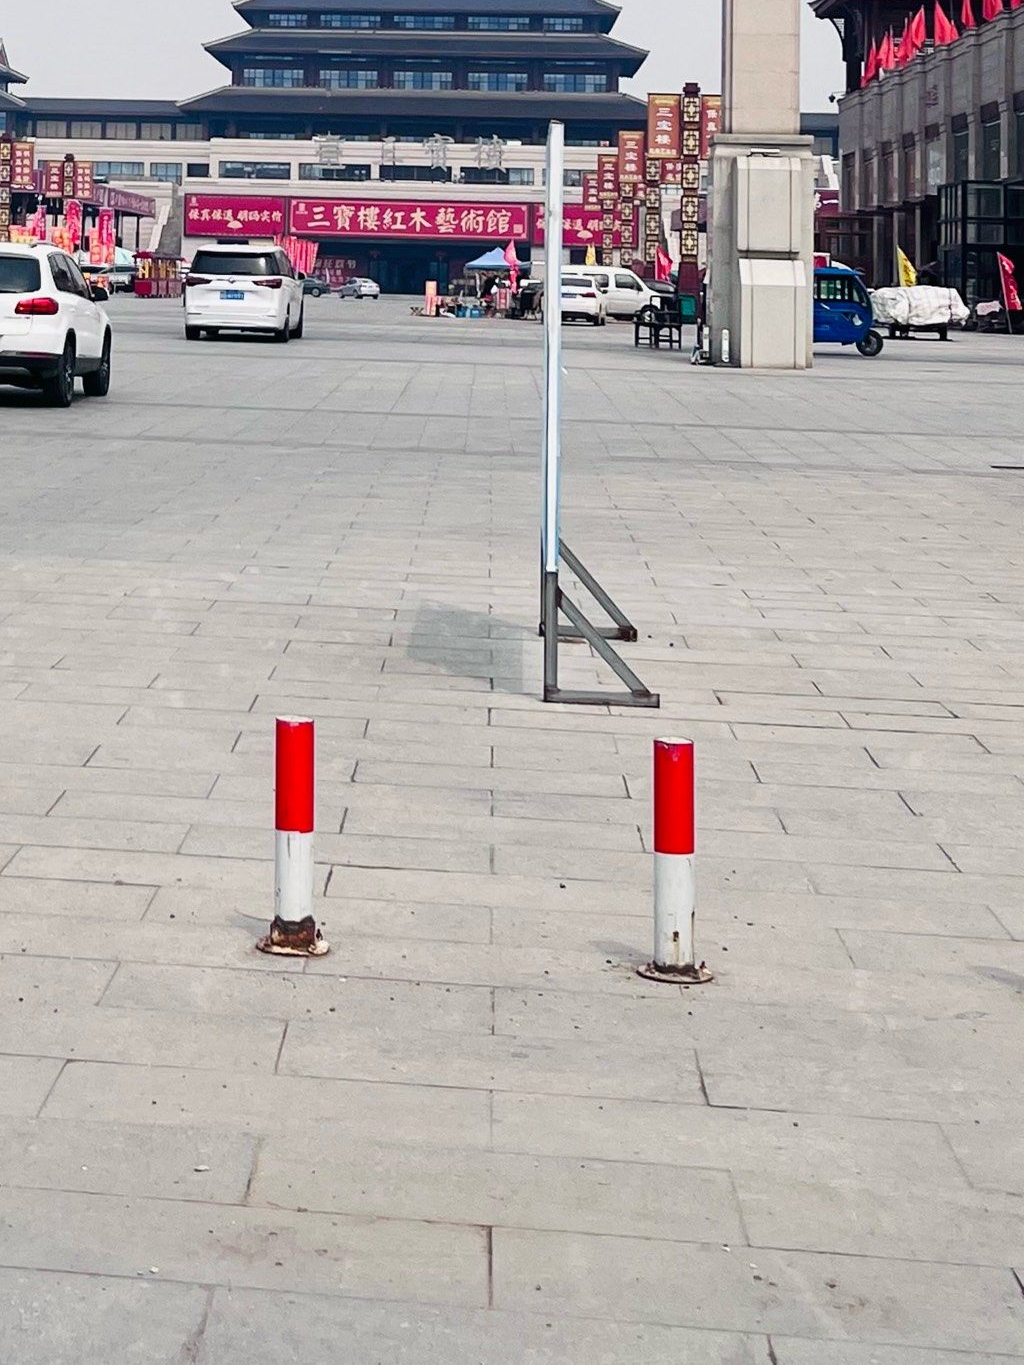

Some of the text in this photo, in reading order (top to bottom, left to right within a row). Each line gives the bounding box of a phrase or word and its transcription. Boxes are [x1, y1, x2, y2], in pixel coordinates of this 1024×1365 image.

[307, 204, 512, 235] 三寶樓紅木藝術館
